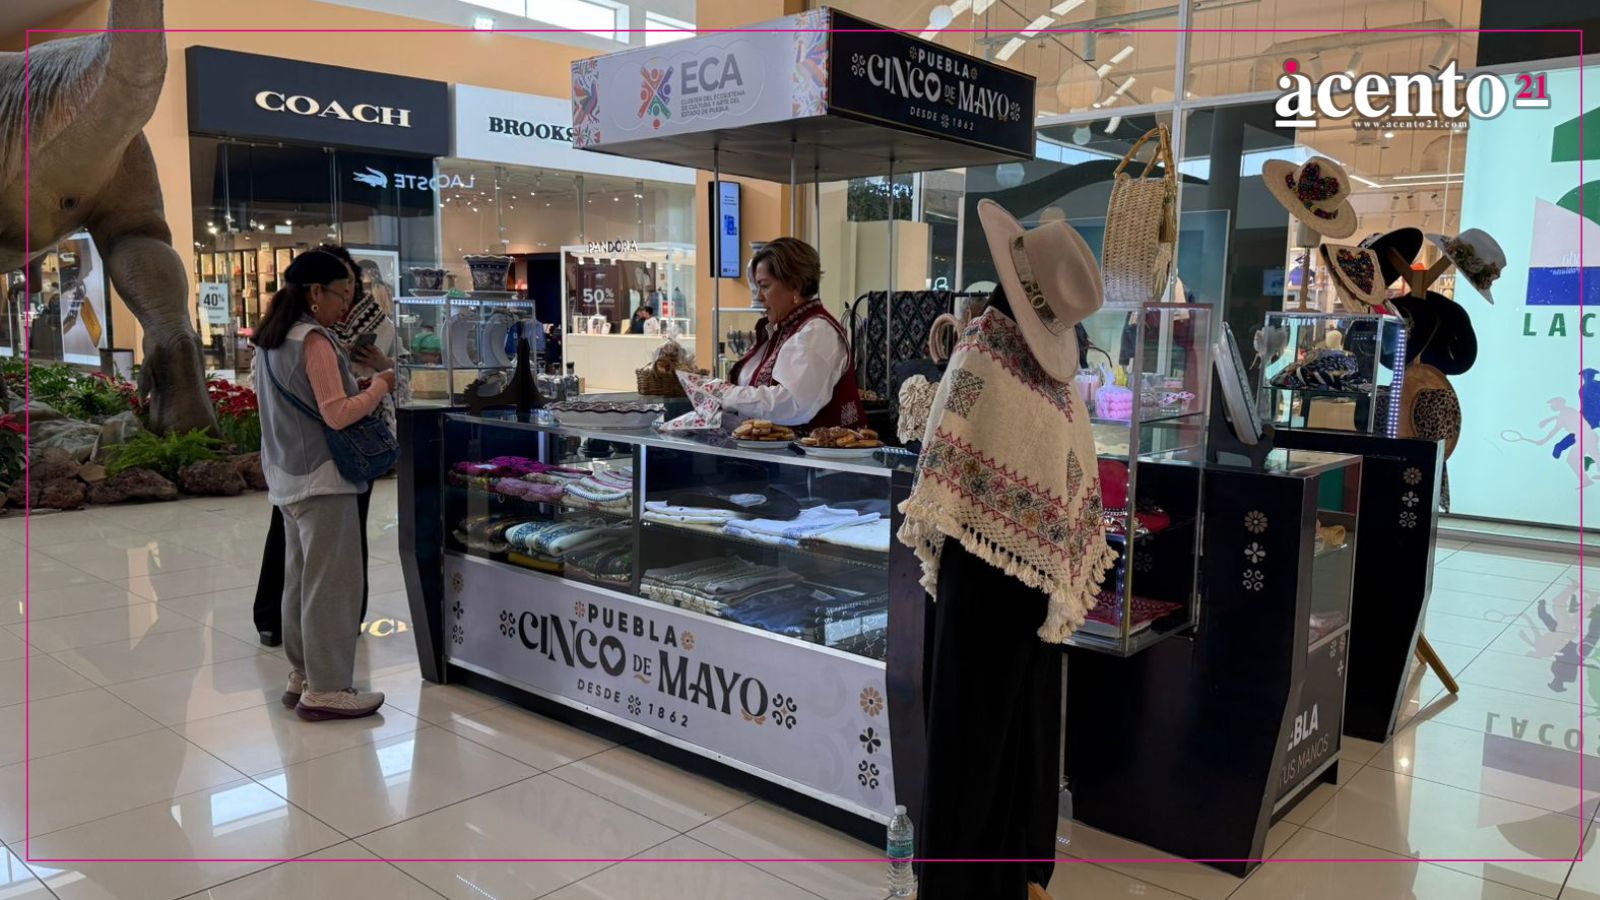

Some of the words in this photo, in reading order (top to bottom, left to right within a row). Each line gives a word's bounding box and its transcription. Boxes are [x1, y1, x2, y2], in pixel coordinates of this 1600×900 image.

[681, 53, 743, 95] ECA
[917, 49, 970, 79] PUEBLA
[867, 54, 942, 103] CINCO
[944, 84, 956, 101] DE
[958, 81, 1010, 119] MAYO
[255, 90, 412, 128] COACH
[910, 106, 938, 121] DESDE
[952, 117, 975, 131] 1862
[588, 239, 638, 253] PANDORA
[1523, 312, 1597, 338] LAC
[588, 604, 678, 648] PUEBLA
[518, 611, 626, 677] CINCO
[633, 654, 652, 676] DE
[658, 649, 769, 718] MAYO
[577, 678, 621, 704] DESDE
[648, 703, 689, 728] 1862
[1297, 732, 1329, 774] MANOS
